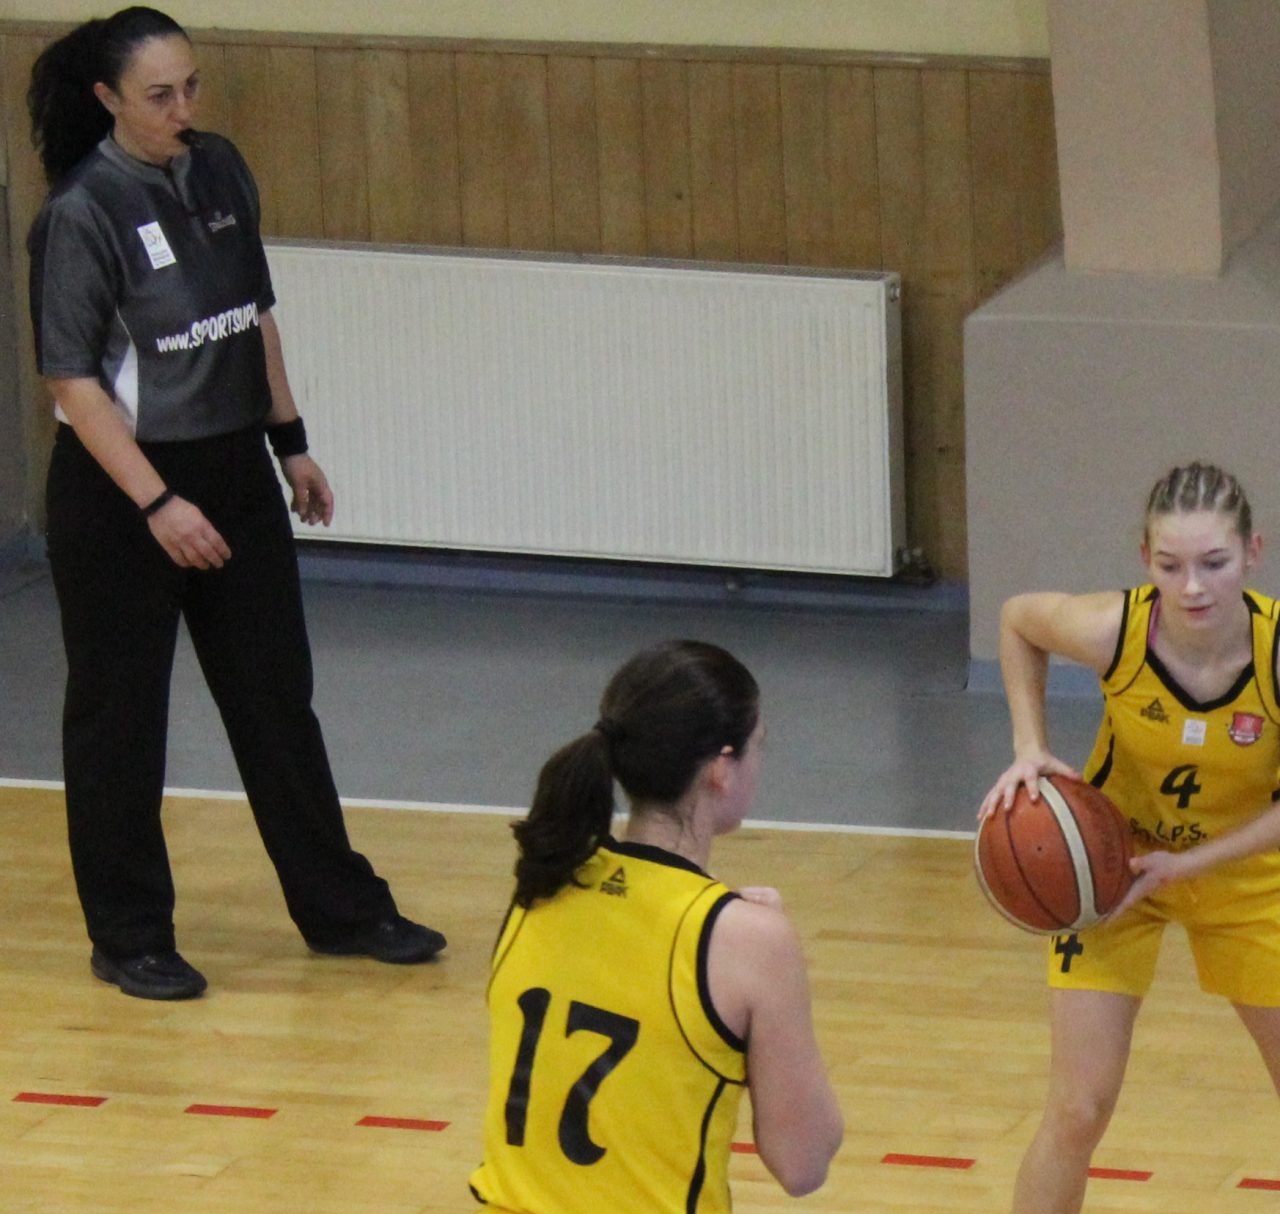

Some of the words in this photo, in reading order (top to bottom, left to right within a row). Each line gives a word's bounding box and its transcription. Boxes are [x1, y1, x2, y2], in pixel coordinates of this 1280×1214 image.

[1160, 764, 1201, 809] 4
[1054, 929, 1084, 973] 4
[504, 987, 640, 1166] 17
